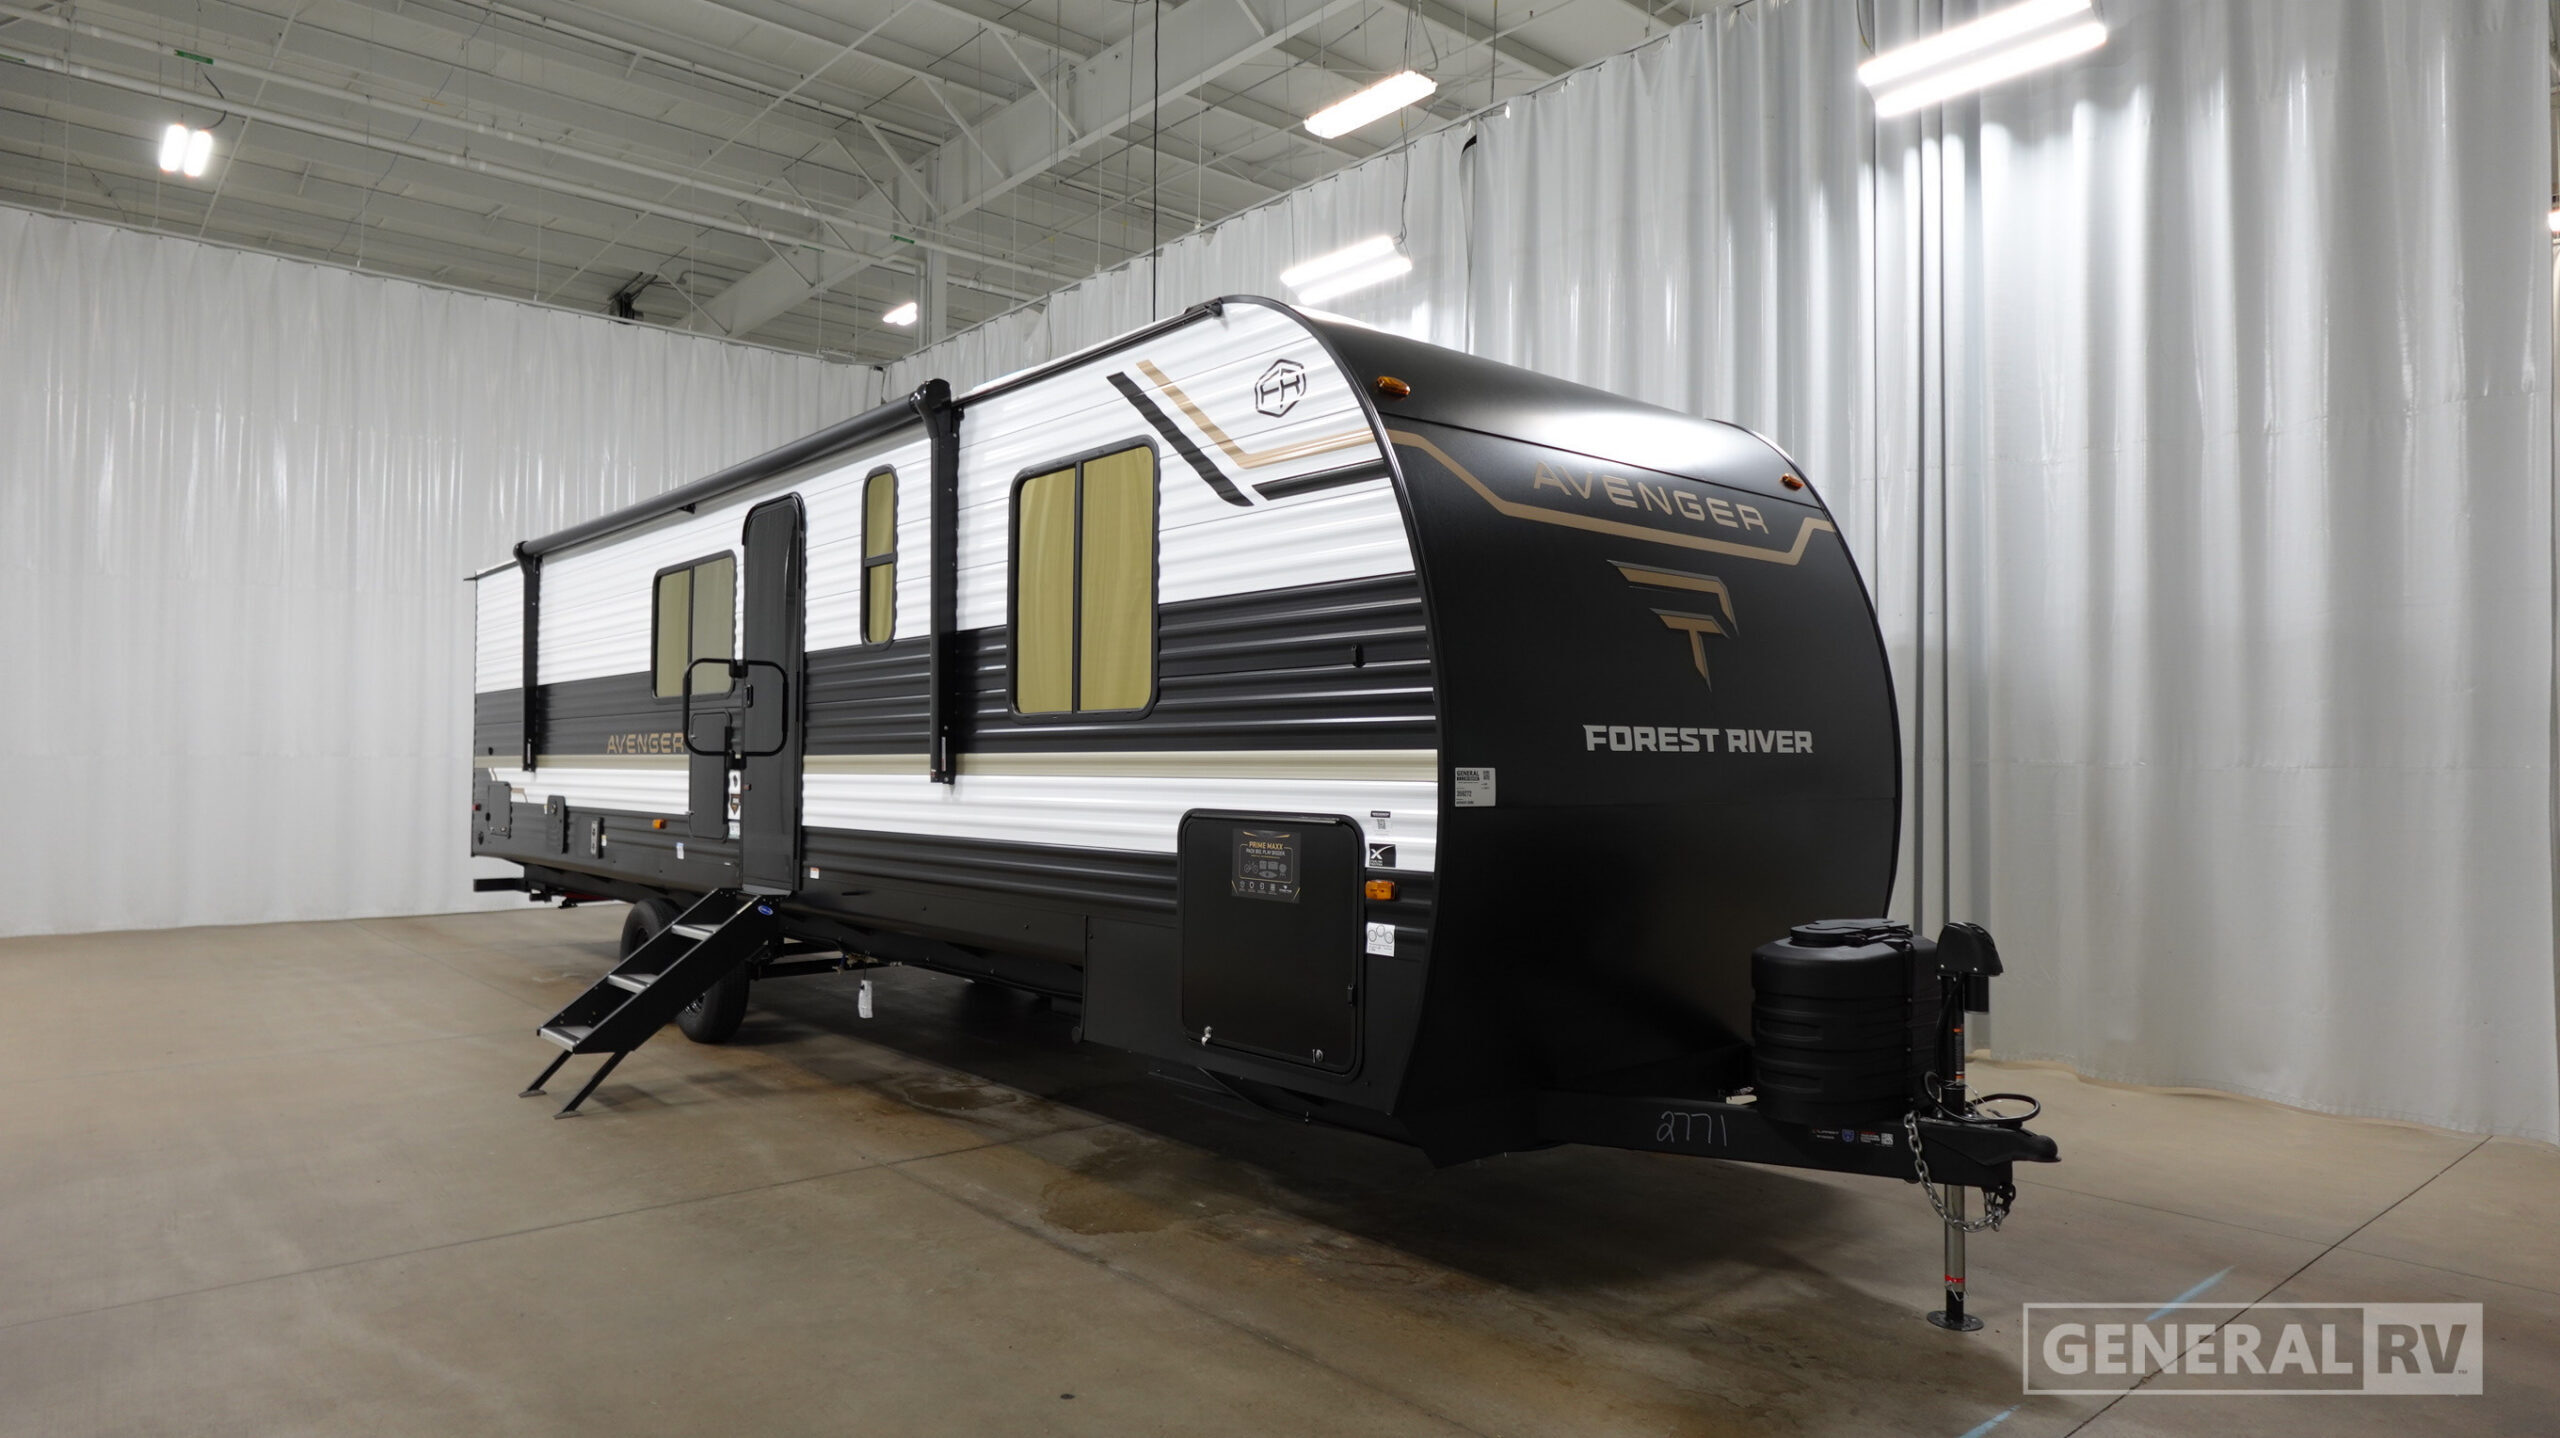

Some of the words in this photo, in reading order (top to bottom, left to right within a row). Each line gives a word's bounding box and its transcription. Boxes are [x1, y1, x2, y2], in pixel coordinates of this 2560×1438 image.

[1533, 461, 1769, 534] AVENGER
[607, 732, 685, 754] AVENGER
[1582, 724, 1720, 752] FOREST
[1725, 728, 1814, 754] RIVER
[1248, 841, 1266, 849] PRIME
[1267, 842, 1284, 850] MAXX
[1656, 1110, 1728, 1147] 2771
